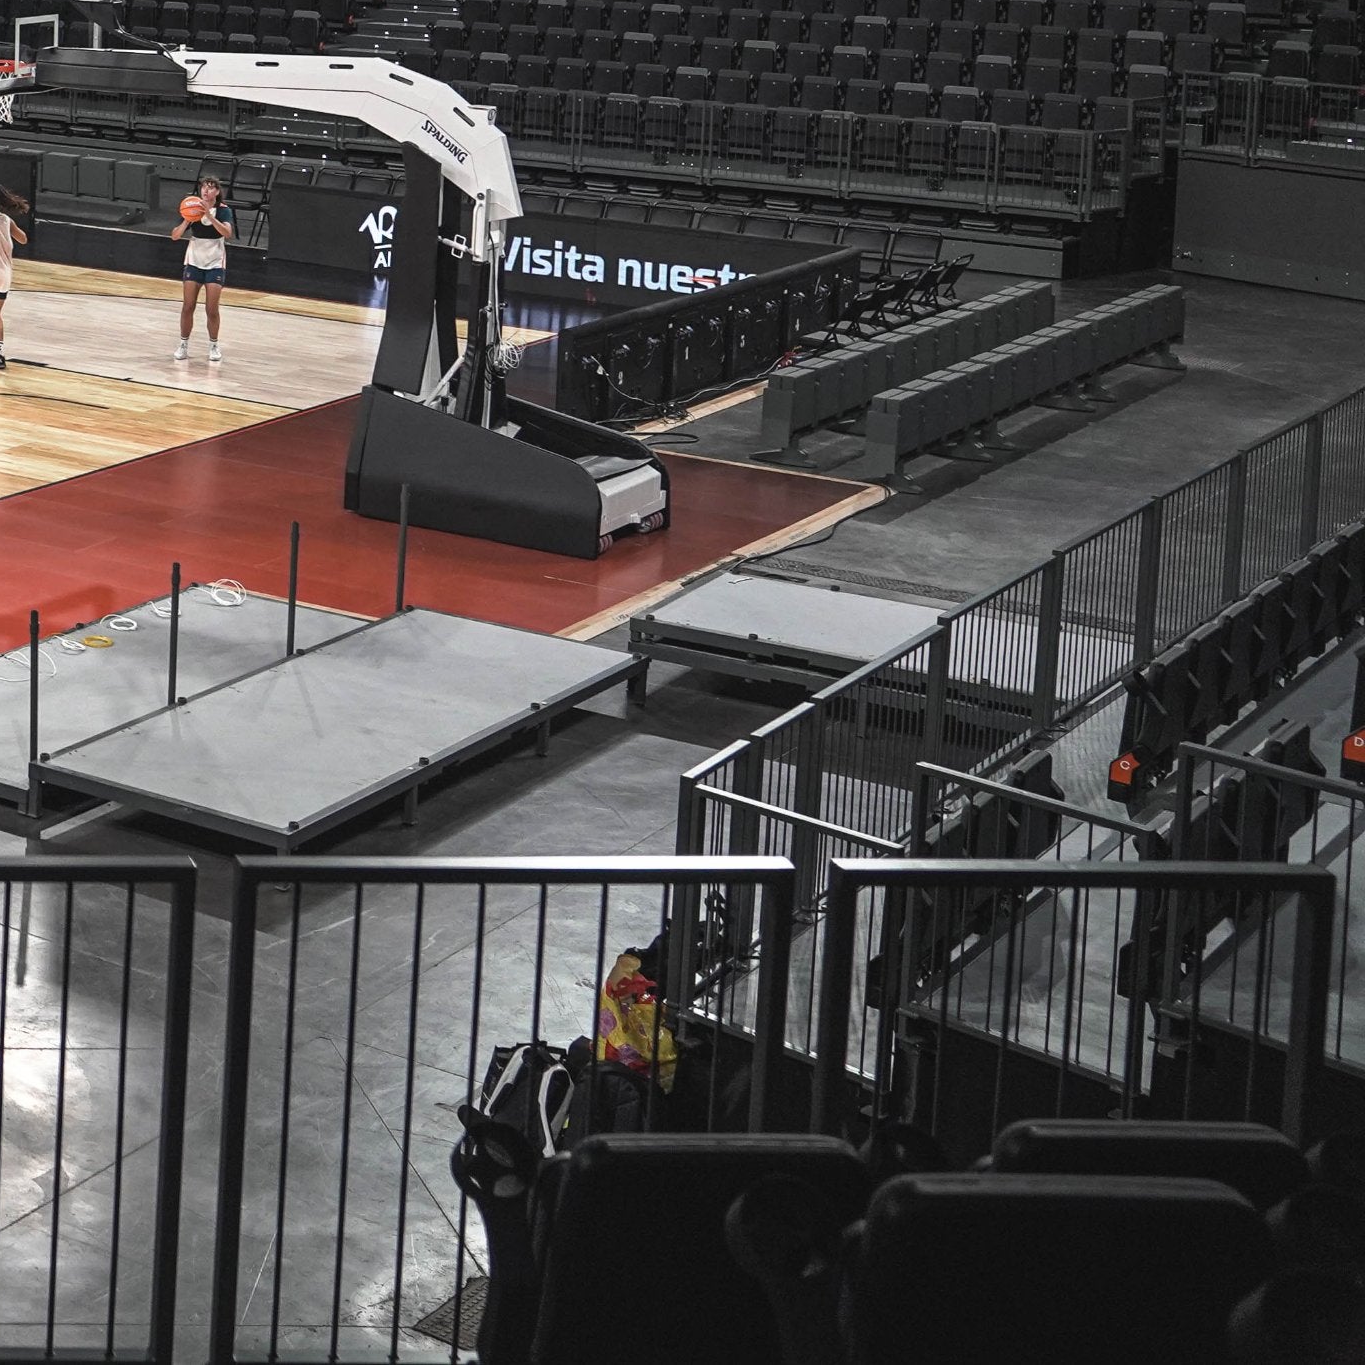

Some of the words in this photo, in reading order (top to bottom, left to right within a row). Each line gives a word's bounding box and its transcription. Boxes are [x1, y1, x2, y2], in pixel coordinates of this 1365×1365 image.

[421, 119, 468, 165] SPALDING
[1354, 736, 1365, 747] D
[1119, 760, 1131, 770] C
